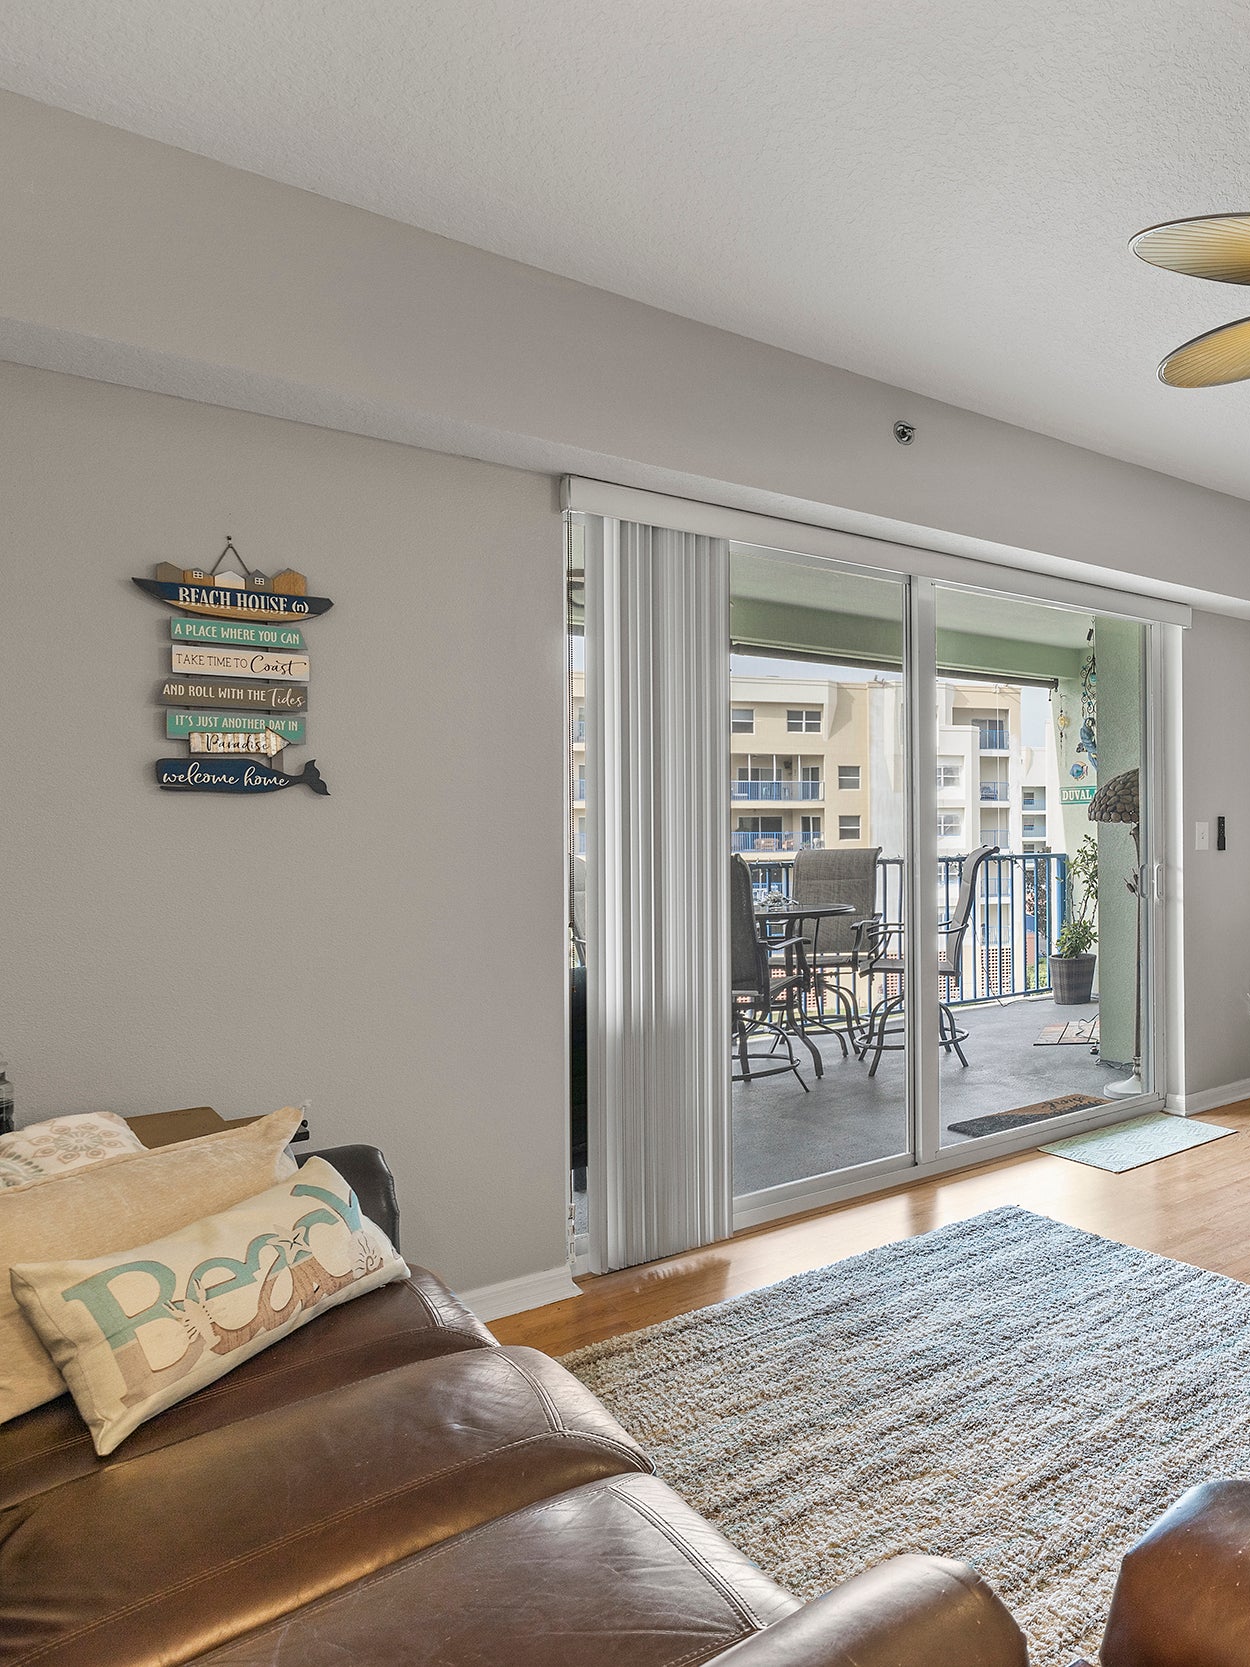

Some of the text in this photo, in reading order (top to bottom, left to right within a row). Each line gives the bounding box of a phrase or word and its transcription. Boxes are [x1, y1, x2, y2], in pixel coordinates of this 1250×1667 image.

[178, 586, 309, 614] BEACH HOUSE (n)
[174, 623, 299, 644] A PLACE WHERE YOU CAN
[176, 653, 307, 676] TAKE TIME TO Coast
[163, 684, 305, 707] AND ROLL WITH THE Tides
[175, 715, 298, 731] IT'S JUST ANOTHER DAY IN
[206, 734, 270, 752] Paradise
[162, 761, 289, 786] welcome home
[1062, 790, 1092, 801] DUVAL
